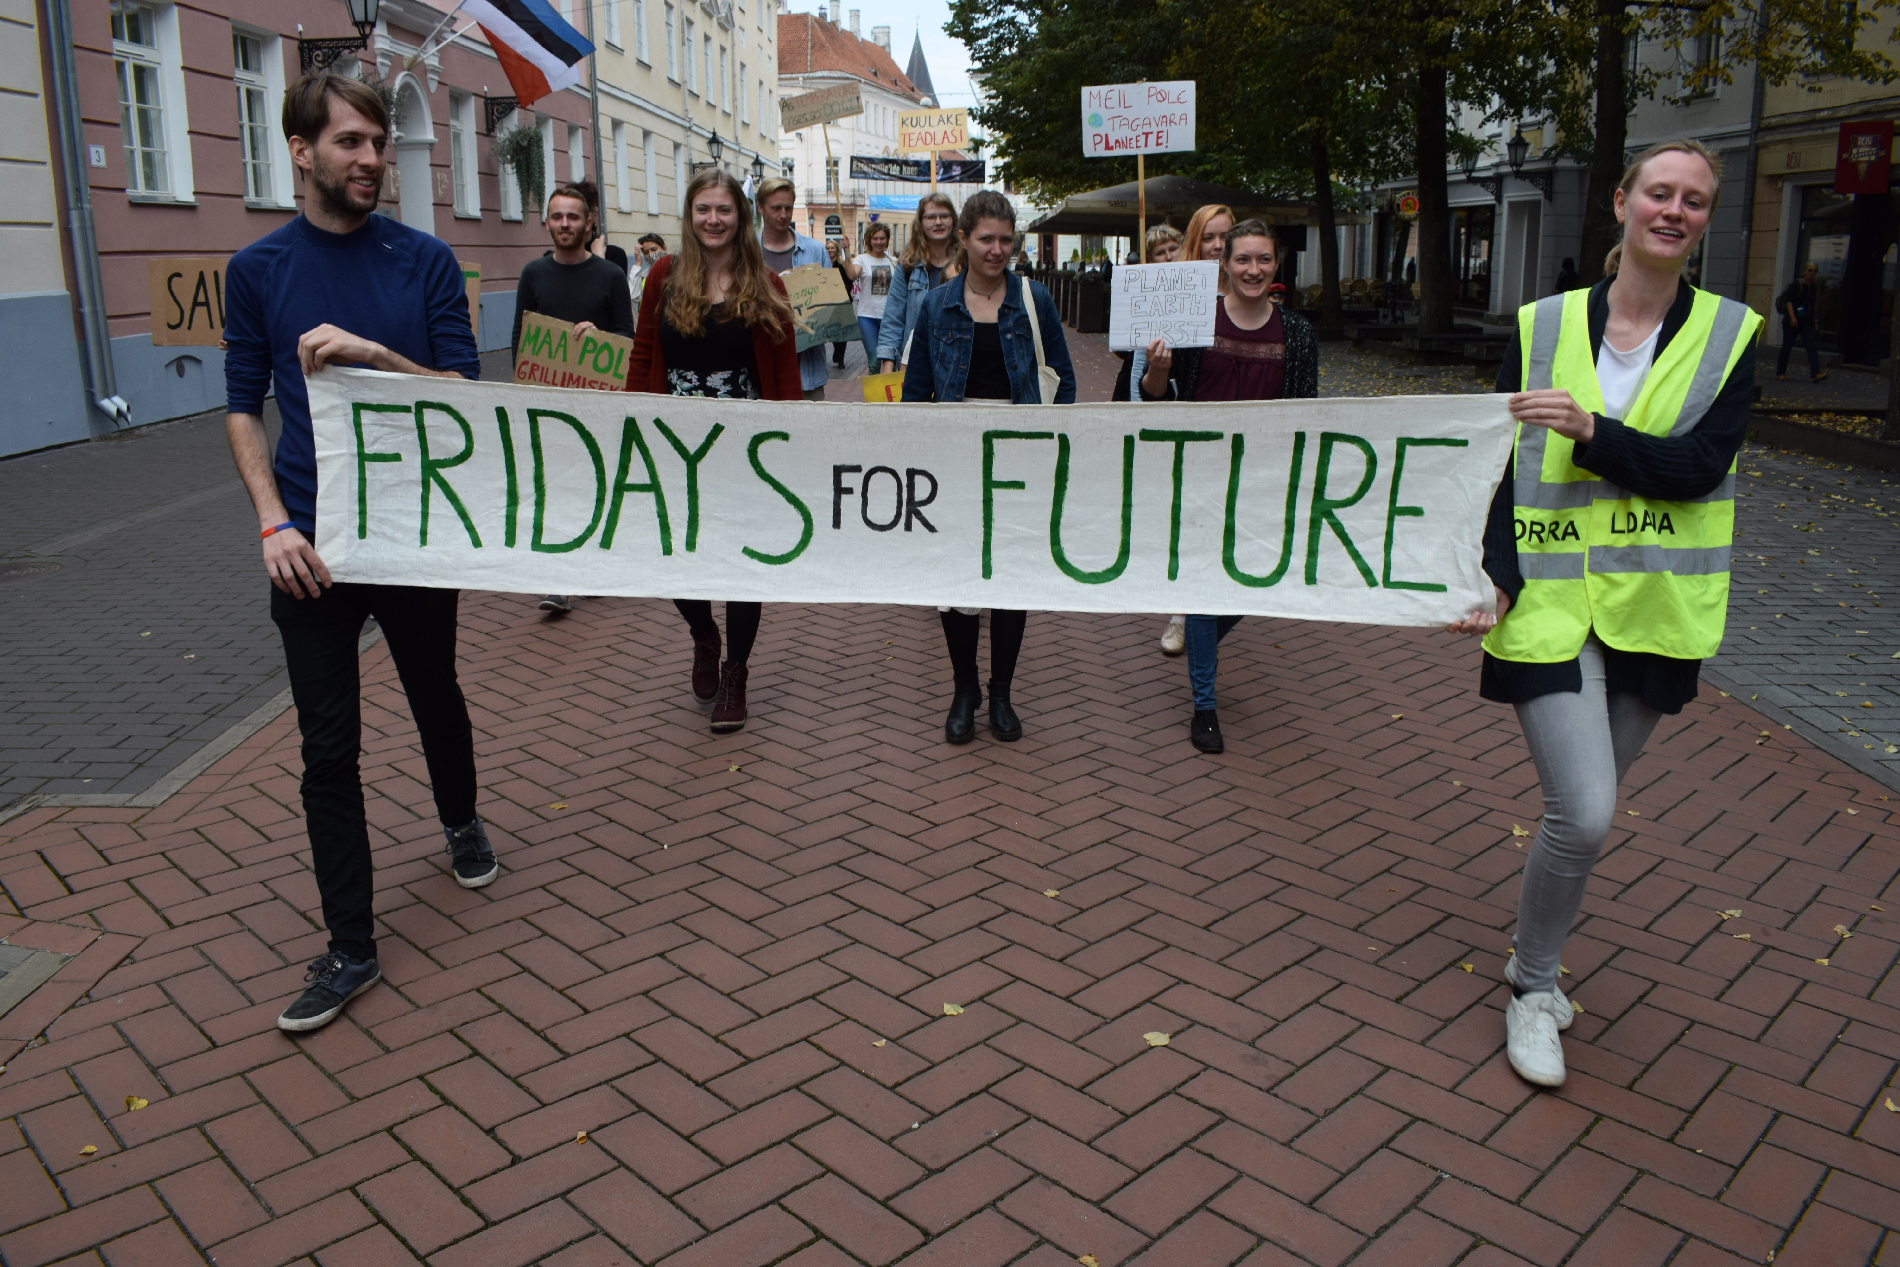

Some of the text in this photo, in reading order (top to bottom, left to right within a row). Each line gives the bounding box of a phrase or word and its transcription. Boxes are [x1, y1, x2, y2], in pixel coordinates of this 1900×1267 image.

[796, 82, 859, 108] TEMPERATURE
[1088, 86, 1187, 109] MEIL POLE
[822, 101, 841, 117] DO
[901, 113, 963, 128] KUULAKE
[1107, 112, 1188, 132] TAGAVARA
[900, 128, 963, 148] TEADLASI
[95, 149, 101, 163] 3
[902, 164, 918, 175] koer
[1123, 268, 1214, 293] PLANET
[1130, 293, 1207, 318] EARTH
[1130, 320, 1208, 347] FIRST
[520, 322, 625, 380] MAA POL
[352, 401, 1469, 593] FRIDAYS FOR FUTURE
